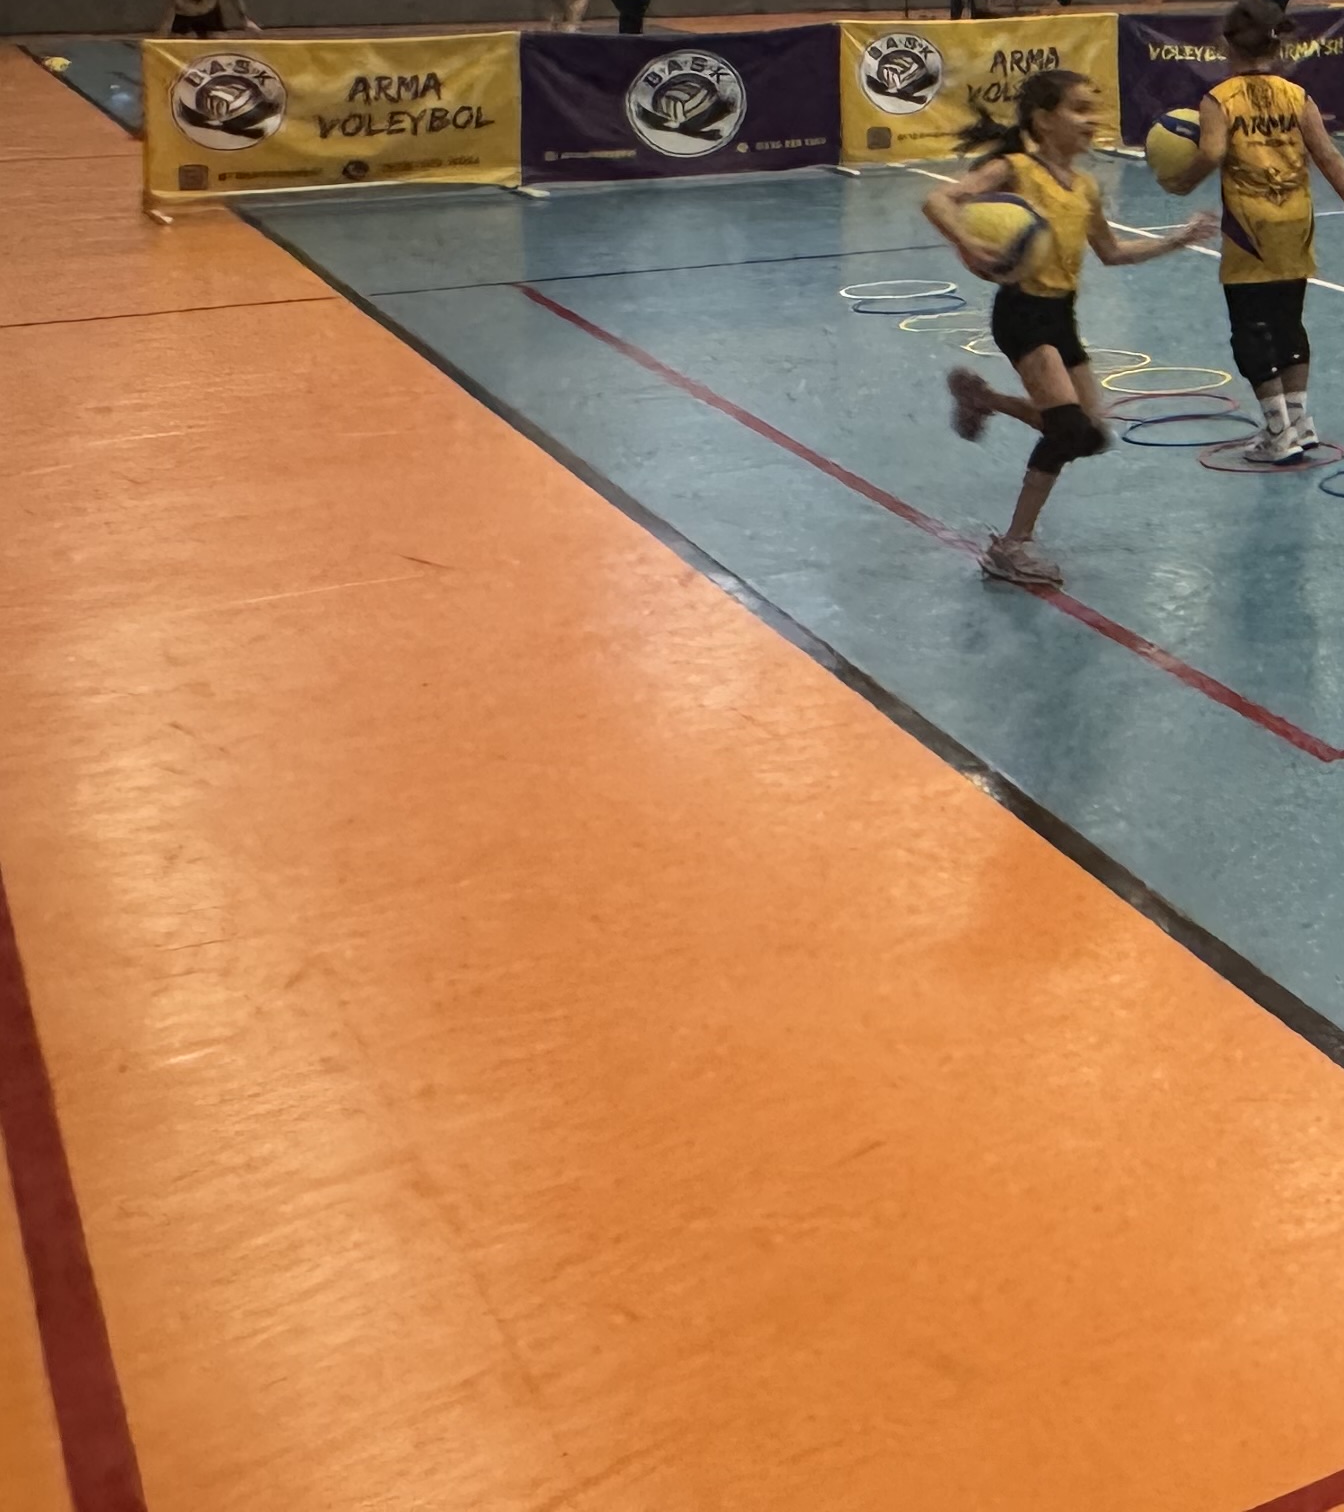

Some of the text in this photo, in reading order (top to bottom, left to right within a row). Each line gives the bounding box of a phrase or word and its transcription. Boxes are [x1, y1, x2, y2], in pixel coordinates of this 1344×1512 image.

[990, 47, 1060, 78] ARMA
[348, 72, 443, 105] ARMA
[317, 106, 495, 139] VOLEYBOL
[1229, 114, 1299, 137] ARMA
